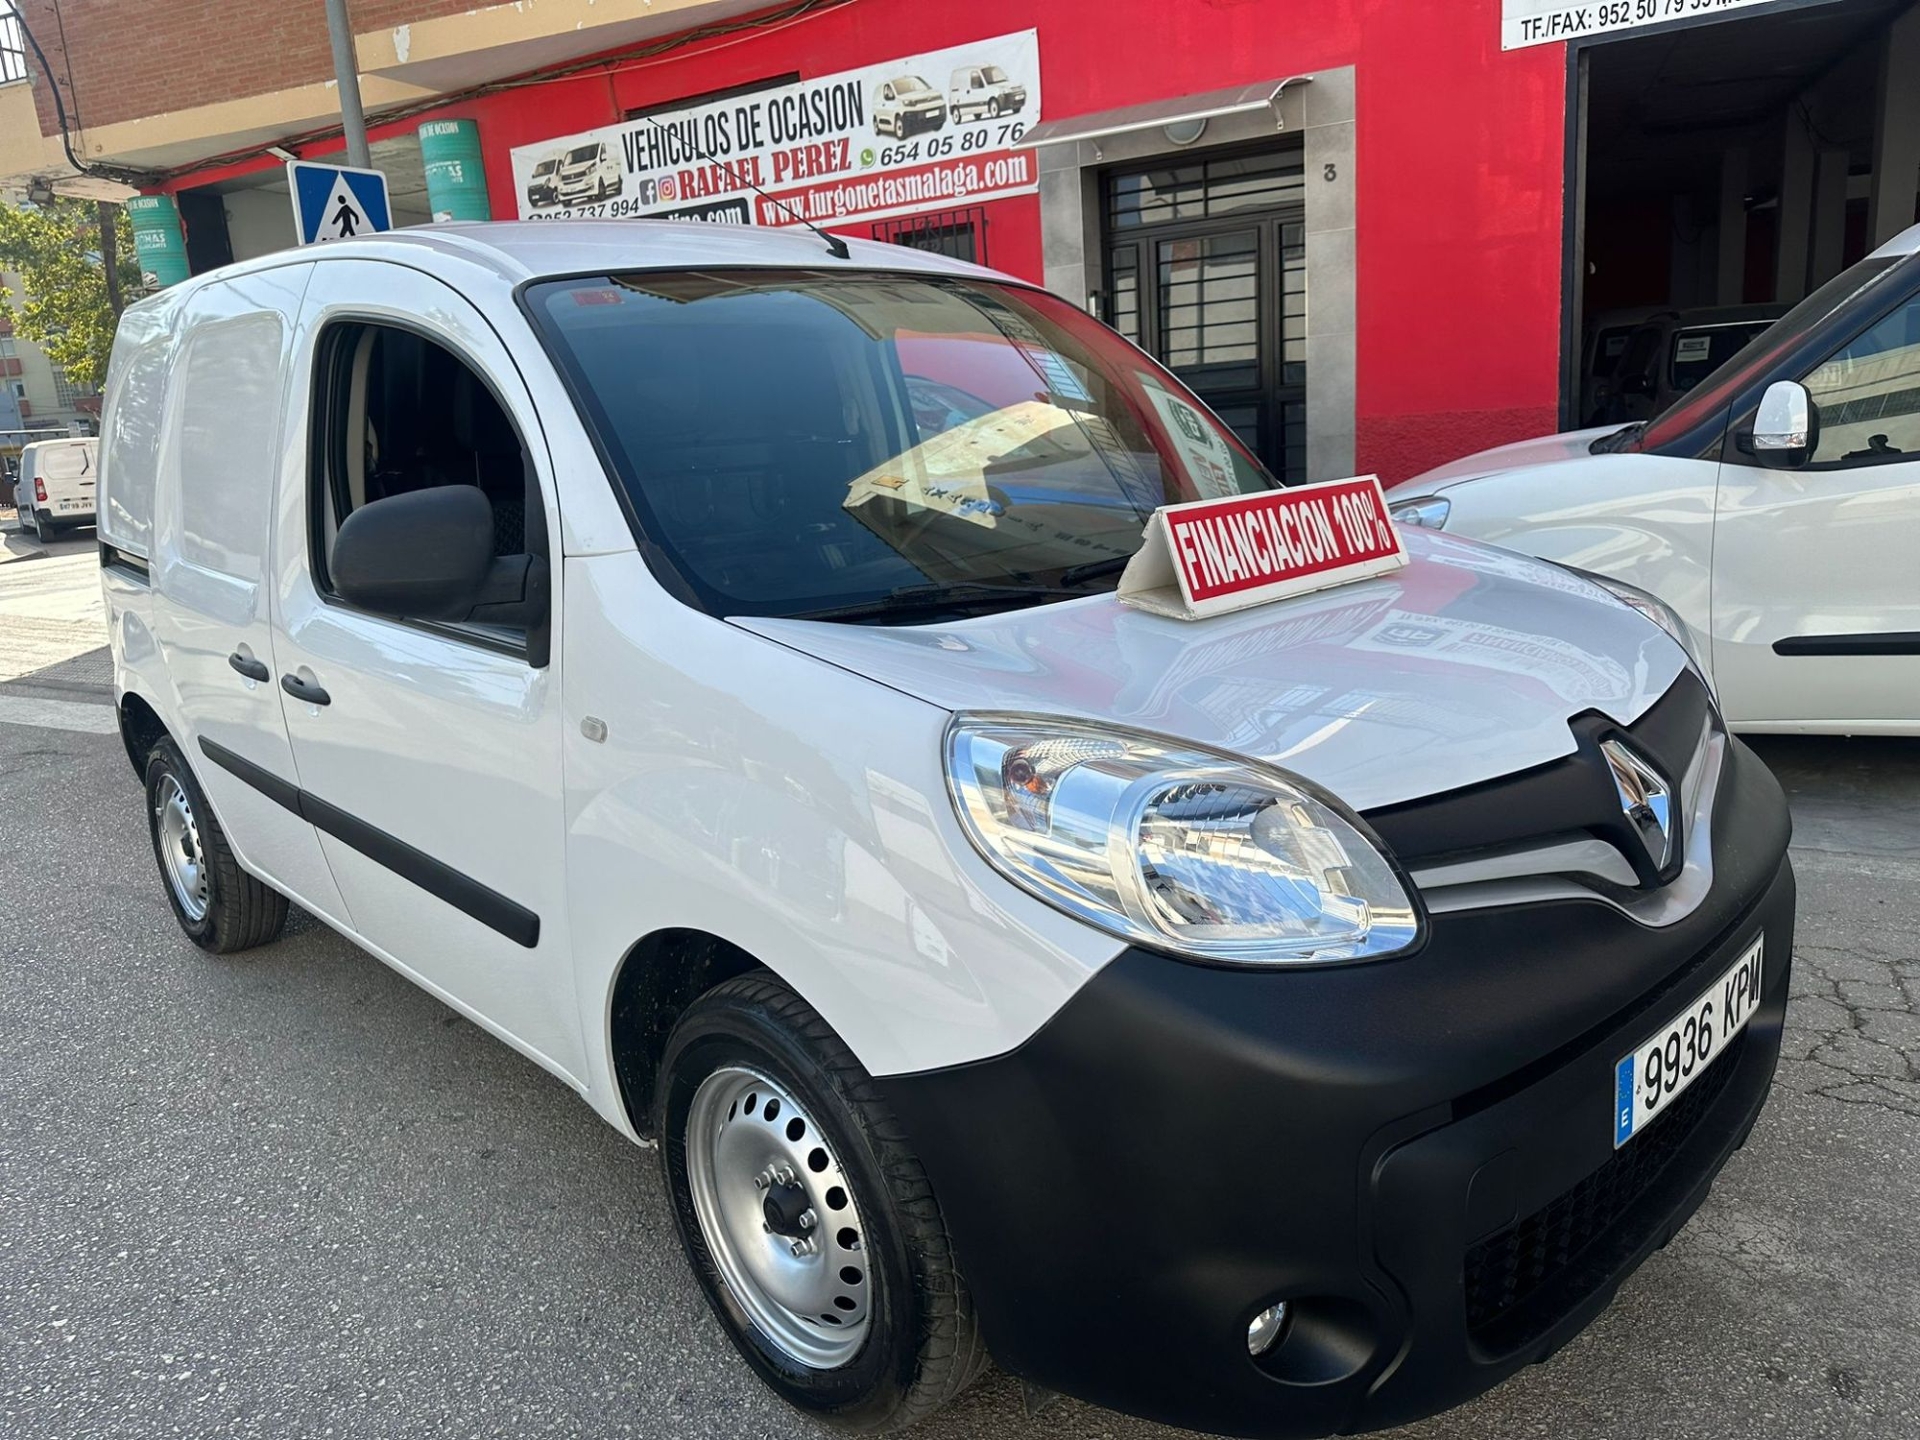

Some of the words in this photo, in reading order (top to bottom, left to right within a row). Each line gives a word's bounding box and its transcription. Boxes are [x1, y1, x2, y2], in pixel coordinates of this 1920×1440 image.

[1521, 9, 1592, 40] TF./FAX:
[1599, 1, 1630, 27] 952
[1636, 0, 1657, 20] 50
[622, 111, 731, 174] VEHICULOS
[736, 103, 764, 151] DE
[768, 80, 864, 145] OCASION
[880, 141, 920, 167] 654
[927, 136, 953, 158] 05
[961, 129, 988, 151] 80
[997, 122, 1025, 145] 76
[677, 156, 766, 200] RAFAEL
[771, 137, 852, 184] PEREZ
[762, 155, 1028, 226] www.furgonetasmalaga.com
[1323, 163, 1337, 182] 3
[611, 197, 639, 218] 994
[1174, 498, 1341, 590] FINANCIACION
[1332, 489, 1392, 556] 100%
[1645, 1001, 1713, 1110] 9936
[1723, 947, 1762, 1038] KPM
[1621, 1107, 1629, 1128] E
